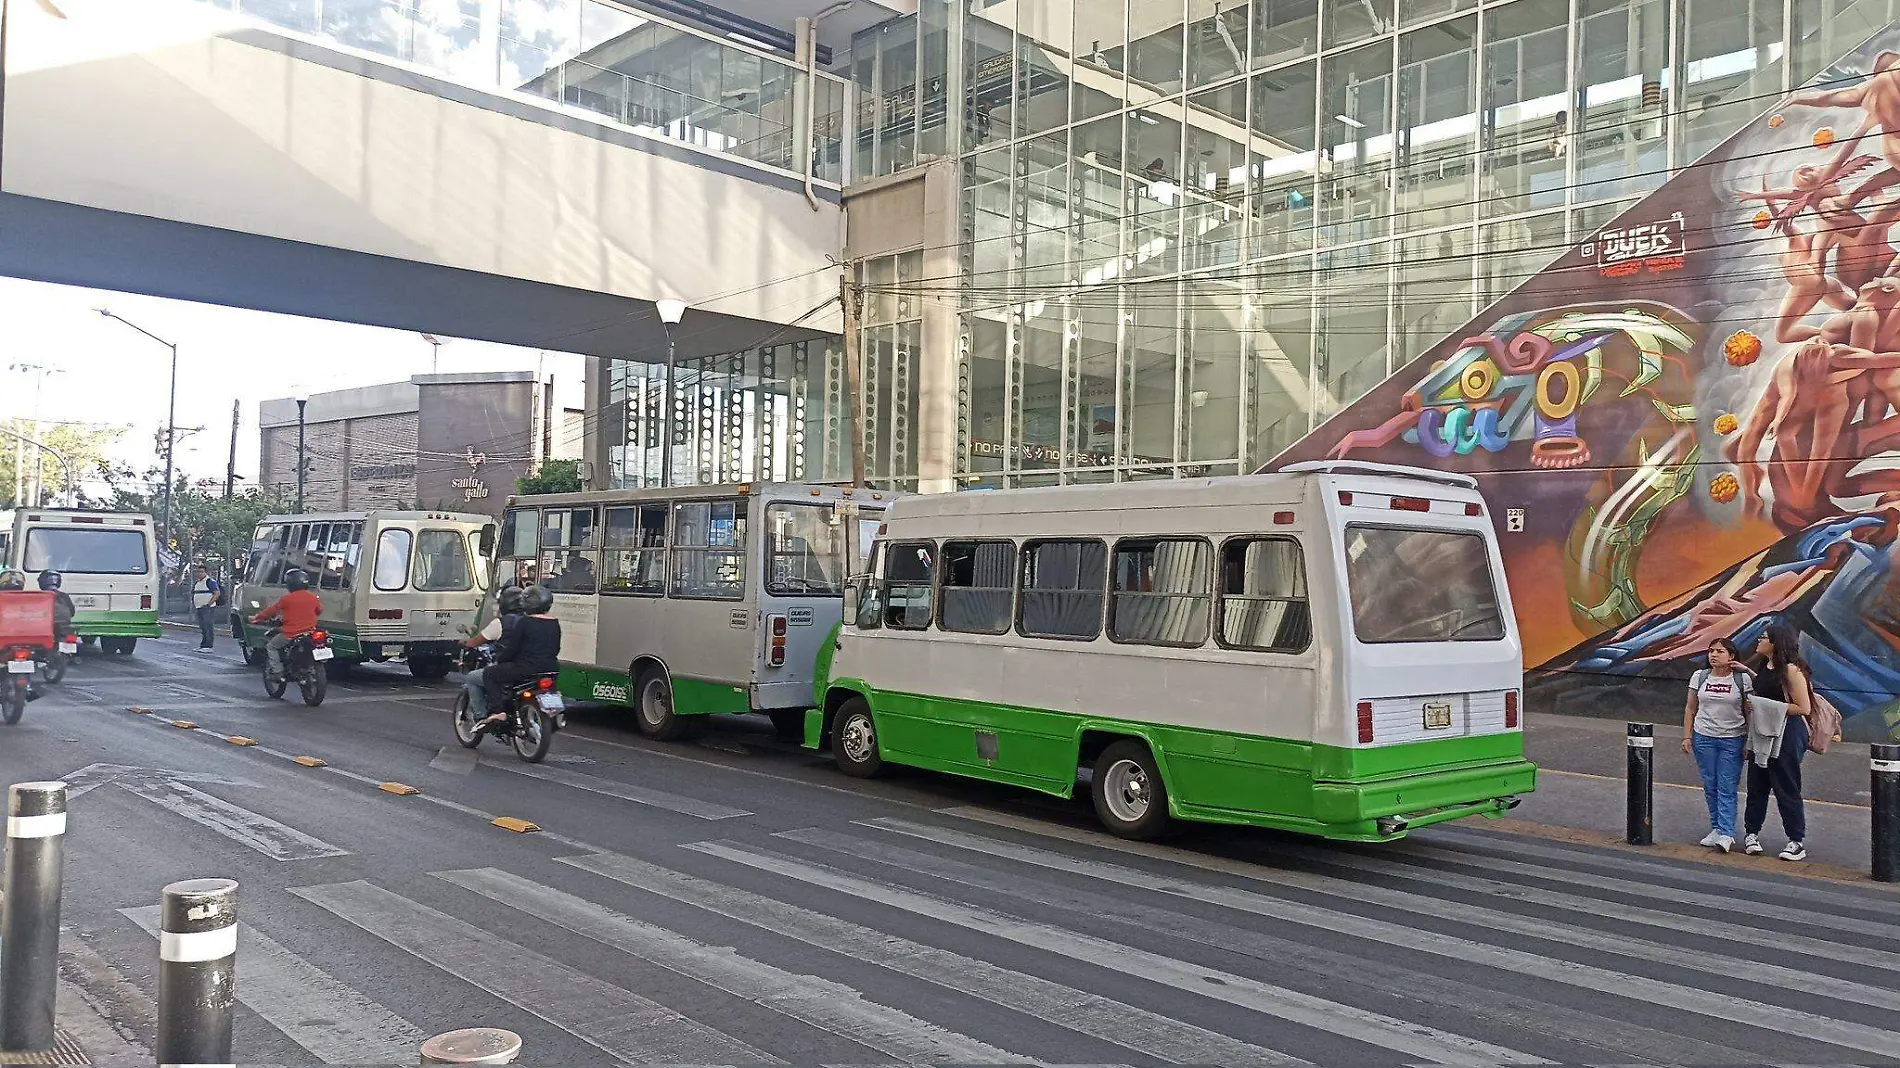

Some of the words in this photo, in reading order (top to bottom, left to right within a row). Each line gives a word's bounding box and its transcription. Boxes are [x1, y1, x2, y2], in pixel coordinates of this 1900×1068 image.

[978, 62, 1013, 78] EMERGEN
[884, 90, 917, 109] SALID
[1603, 225, 1672, 255] DUEK
[975, 442, 990, 453] NO
[1045, 450, 1060, 460] NO
[451, 477, 477, 488] santo
[464, 482, 489, 503] gallo
[1508, 509, 1524, 517] 220
